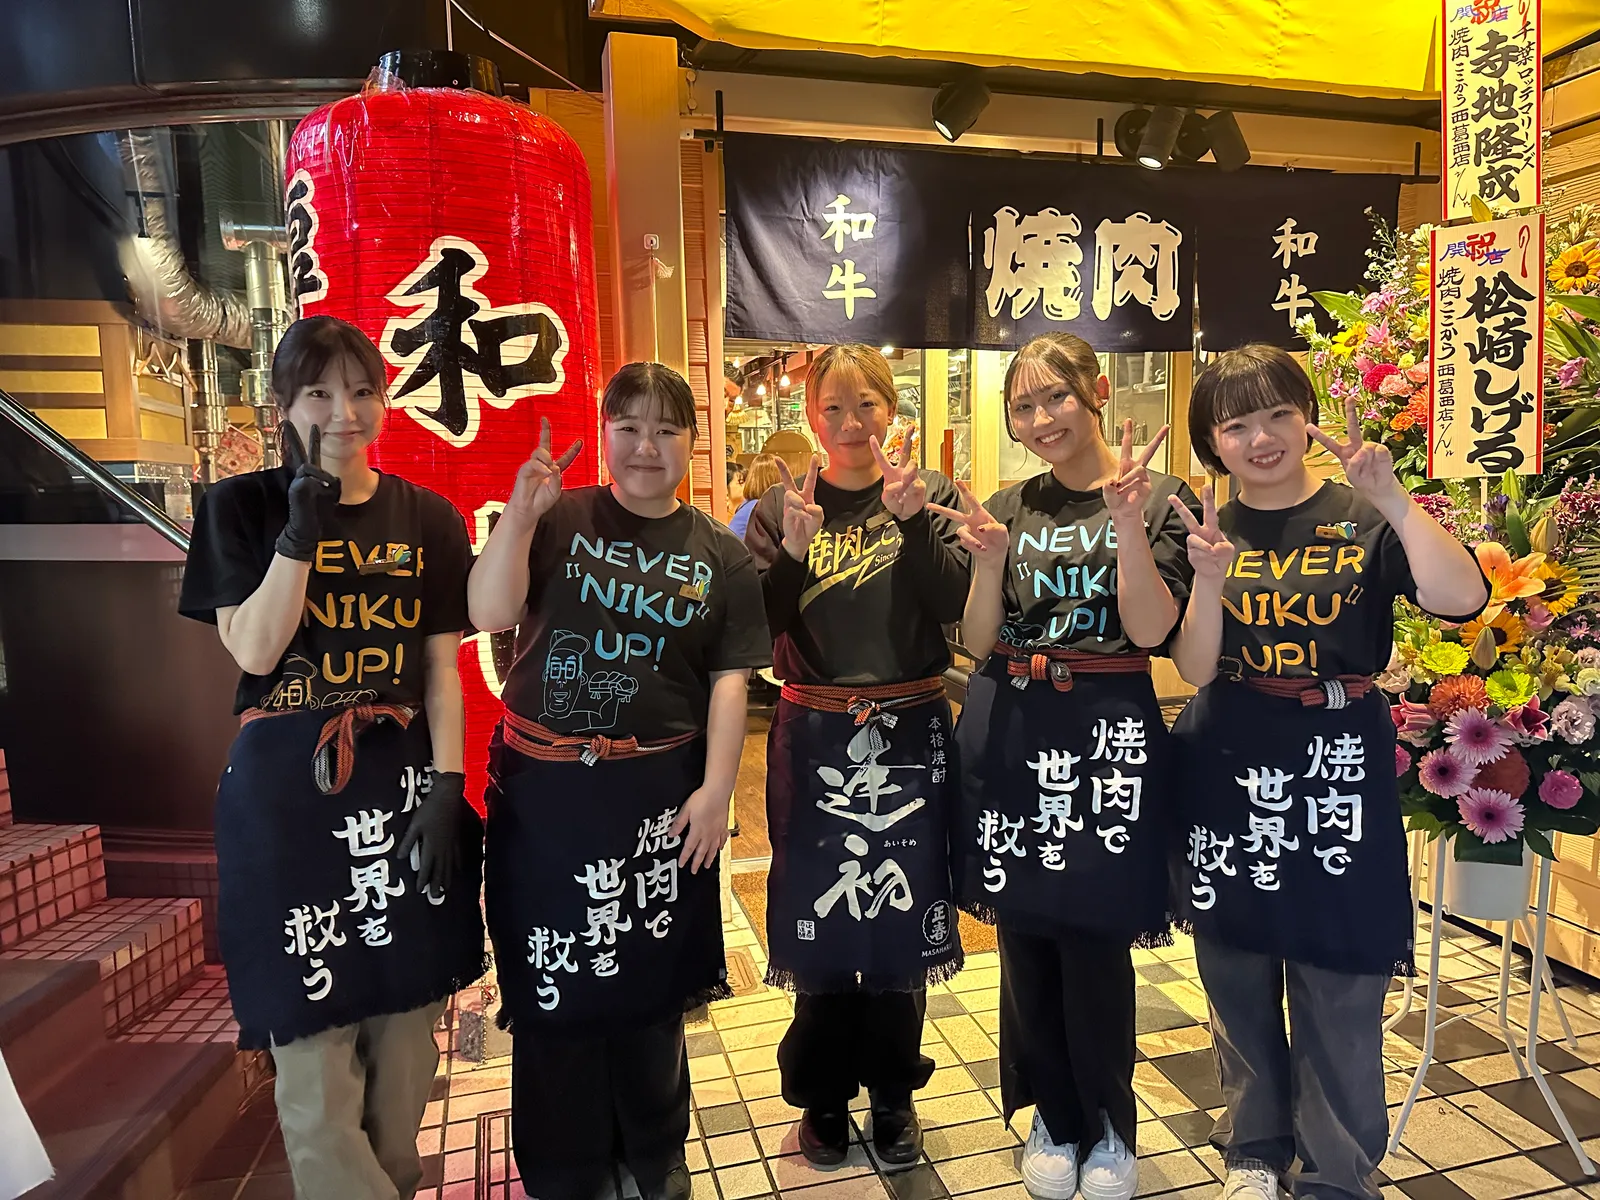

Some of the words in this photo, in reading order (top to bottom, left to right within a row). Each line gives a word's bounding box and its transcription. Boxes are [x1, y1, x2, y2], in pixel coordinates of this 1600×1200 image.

[1470, 29, 1525, 203] 寺地隆成
[1512, 21, 1536, 170] 千葉ロッテマリーンズ
[821, 193, 877, 320] 和牛
[983, 206, 1182, 322] 焼肉
[1271, 217, 1319, 328] 和牛
[1457, 270, 1537, 474] 松崎しげる
[570, 532, 713, 585] NEVER
[322, 643, 404, 685] UP!
[594, 629, 666, 672] UP!
[1048, 607, 1108, 642] UP!
[1241, 640, 1319, 676] UP!
[929, 716, 947, 784] 本格焼酎
[1089, 716, 1148, 854] 焼肉で
[1302, 732, 1366, 876] 焼肉で
[883, 838, 917, 848] あいそめ
[976, 809, 1026, 893] 救う
[1026, 748, 1084, 871] 世界を
[1235, 766, 1300, 891] 世界を
[332, 809, 406, 947] 世界を
[573, 857, 632, 977] 世界を
[633, 806, 681, 938] 焼肉で
[930, 904, 947, 941] 正春
[1186, 824, 1237, 910] 救う
[284, 900, 347, 1001] 救う
[527, 926, 579, 1011] 救う
